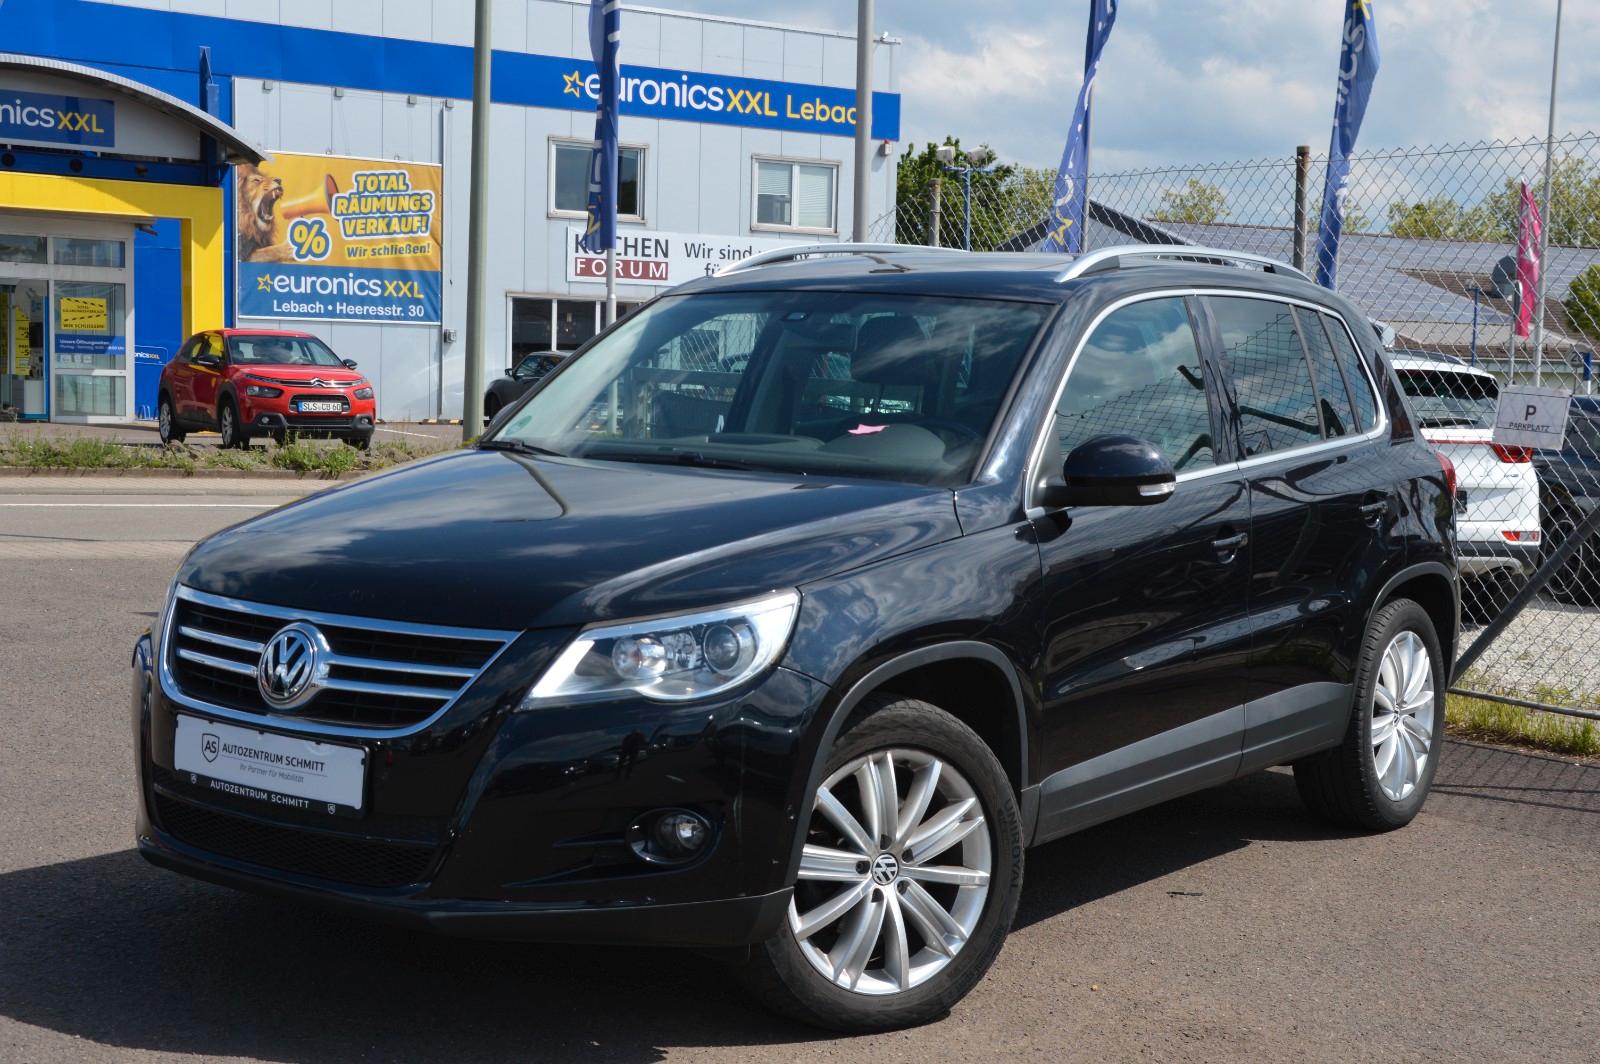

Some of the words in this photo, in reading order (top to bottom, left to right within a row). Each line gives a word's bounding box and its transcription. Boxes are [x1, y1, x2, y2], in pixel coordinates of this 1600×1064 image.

[787, 94, 857, 125] Lebac
[356, 174, 408, 192] TOTAL
[336, 194, 432, 215] RÄUMUNGS
[344, 215, 429, 235] VERKAUF!
[346, 246, 368, 258] Wir
[370, 243, 431, 257] schließen!
[575, 234, 669, 259] KCHEN
[684, 242, 711, 259] Wir
[719, 244, 752, 261] sind
[576, 259, 666, 279] FORUM
[273, 299, 324, 314] Lebach
[336, 302, 404, 317] Heeresstr.
[408, 305, 424, 317] 30
[1524, 404, 1537, 421] P
[1509, 422, 1551, 432] PARKPLATZ
[204, 739, 218, 754] AS
[222, 743, 284, 765] AUTOZENTRUM
[285, 755, 325, 772] SCHMITT
[210, 779, 268, 801] AUTOZENTRUM
[271, 793, 310, 809] SCHMITT
